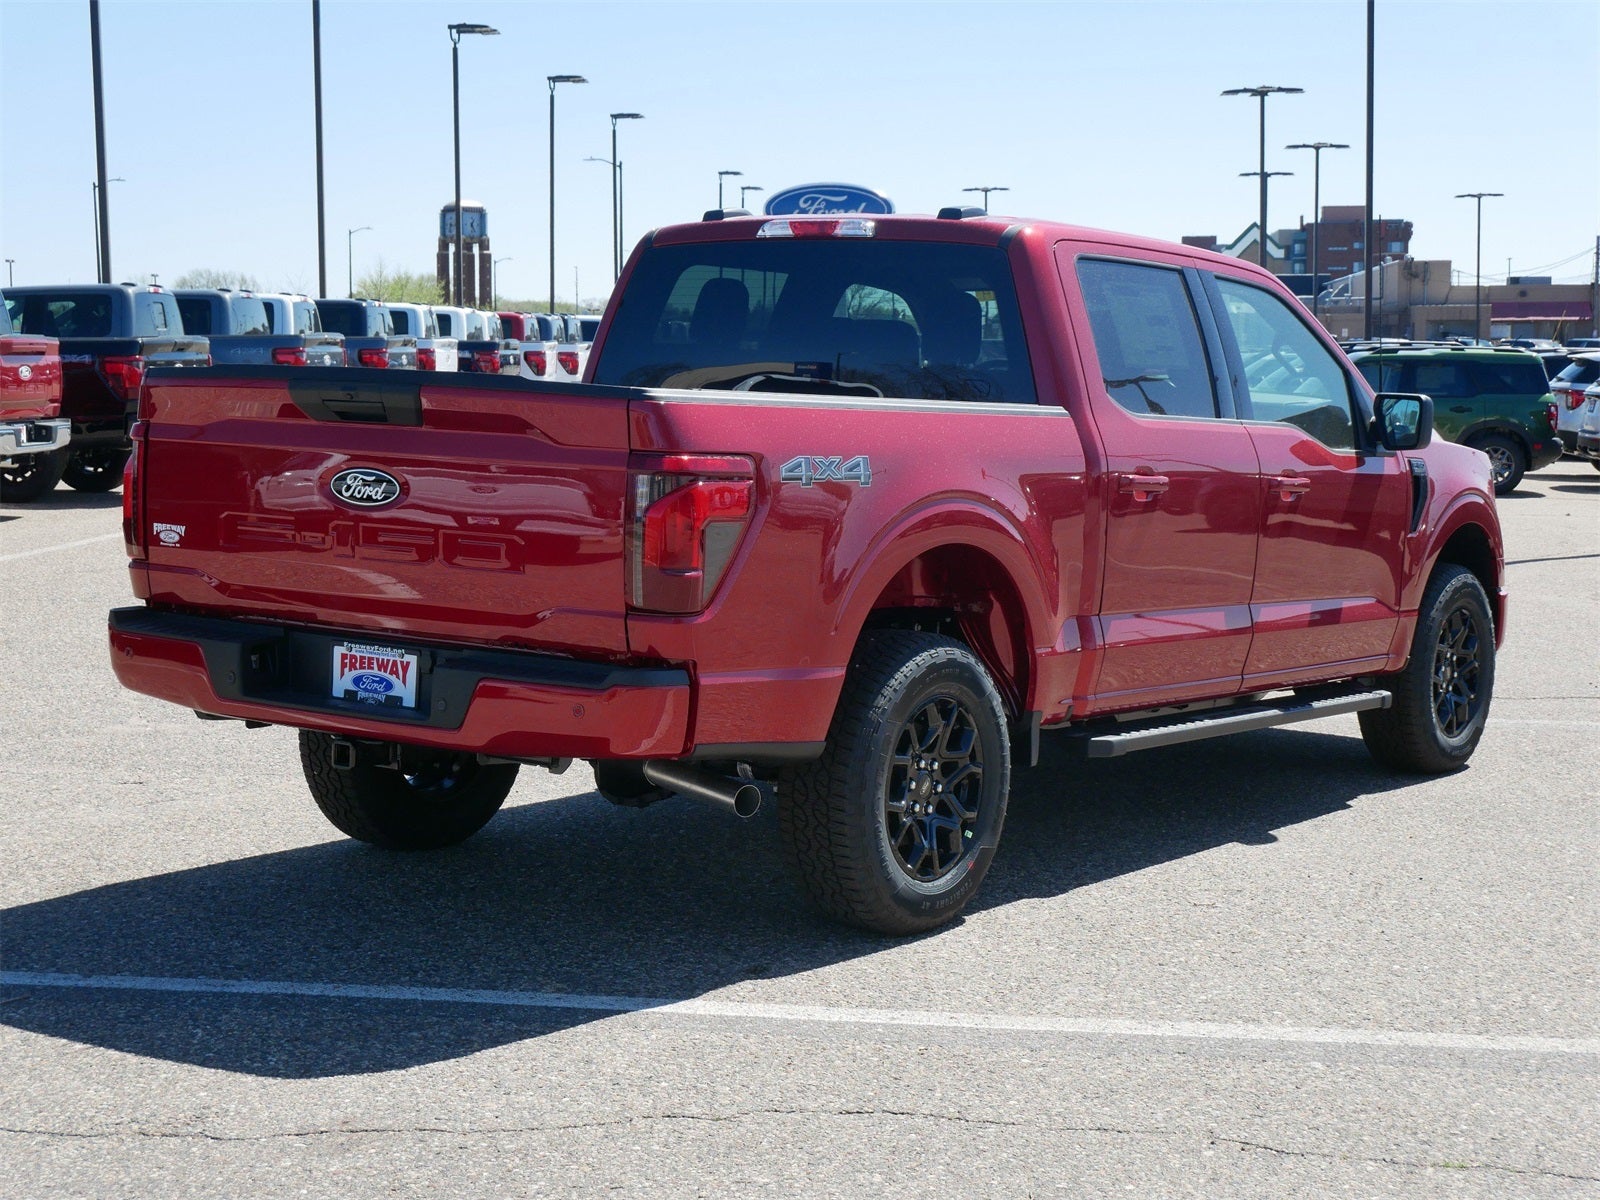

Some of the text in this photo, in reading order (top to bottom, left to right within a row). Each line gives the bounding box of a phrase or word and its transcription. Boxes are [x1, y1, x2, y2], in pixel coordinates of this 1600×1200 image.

[793, 193, 867, 215] Fd
[341, 473, 386, 500] Ford
[153, 522, 186, 537] FREEWAY
[340, 653, 410, 688] FREEWAY
[360, 675, 386, 691] Ford
